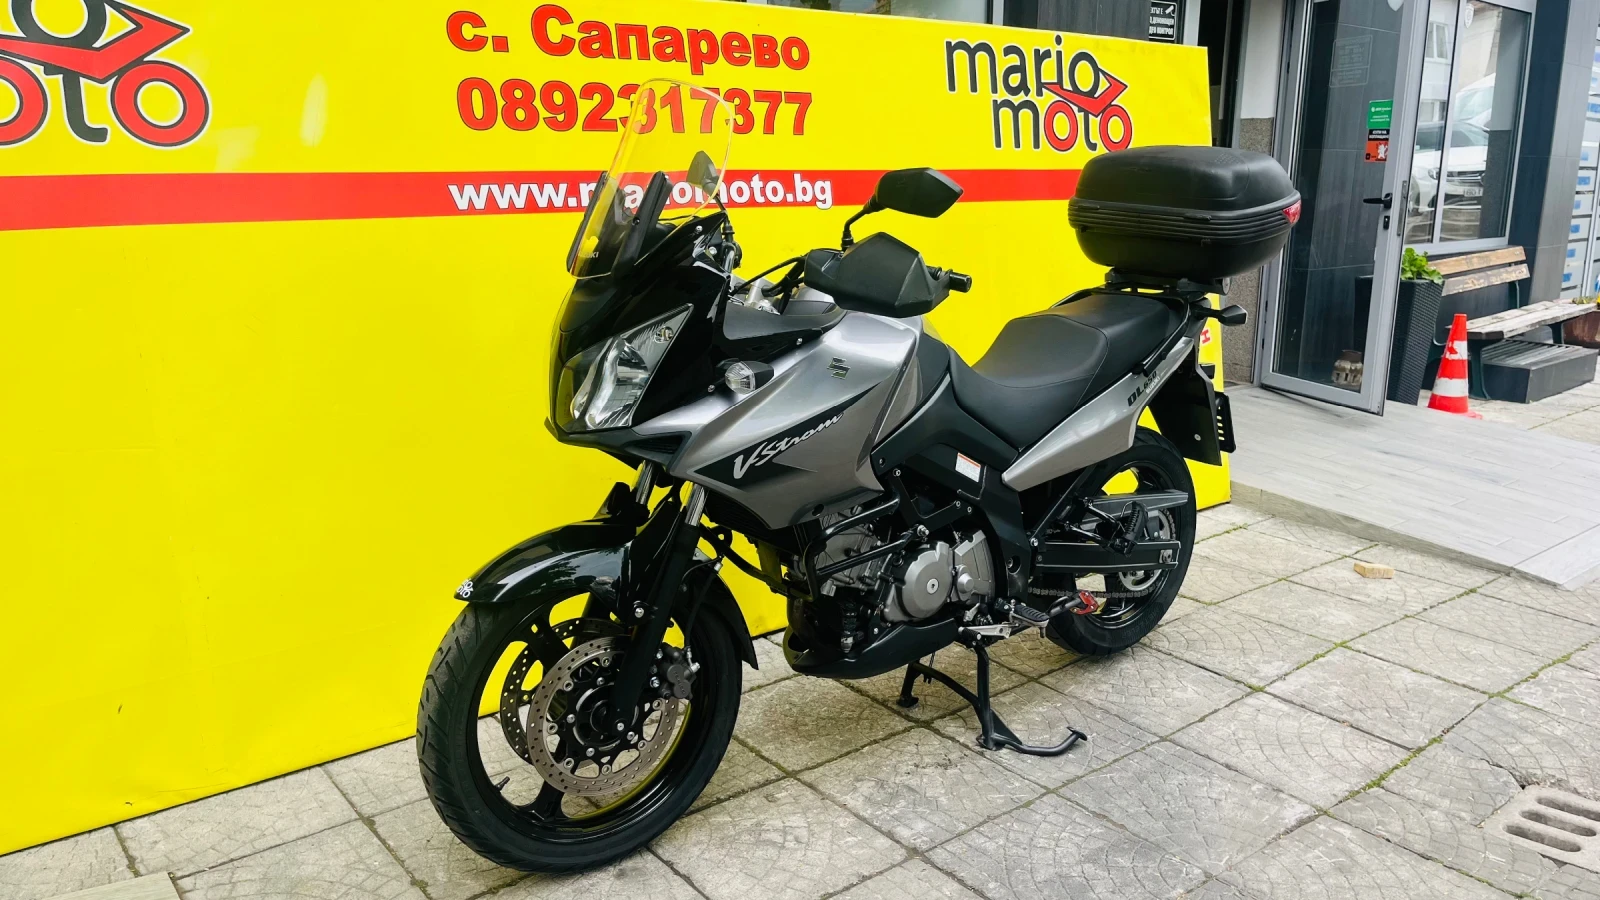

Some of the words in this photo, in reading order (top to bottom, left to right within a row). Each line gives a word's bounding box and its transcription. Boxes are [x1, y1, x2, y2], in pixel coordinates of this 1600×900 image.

[446, 10, 509, 53] с.
[531, 4, 811, 76] Сапарево
[945, 34, 1101, 98] mario
[456, 76, 812, 135] 0892317377
[992, 97, 1133, 153] moto
